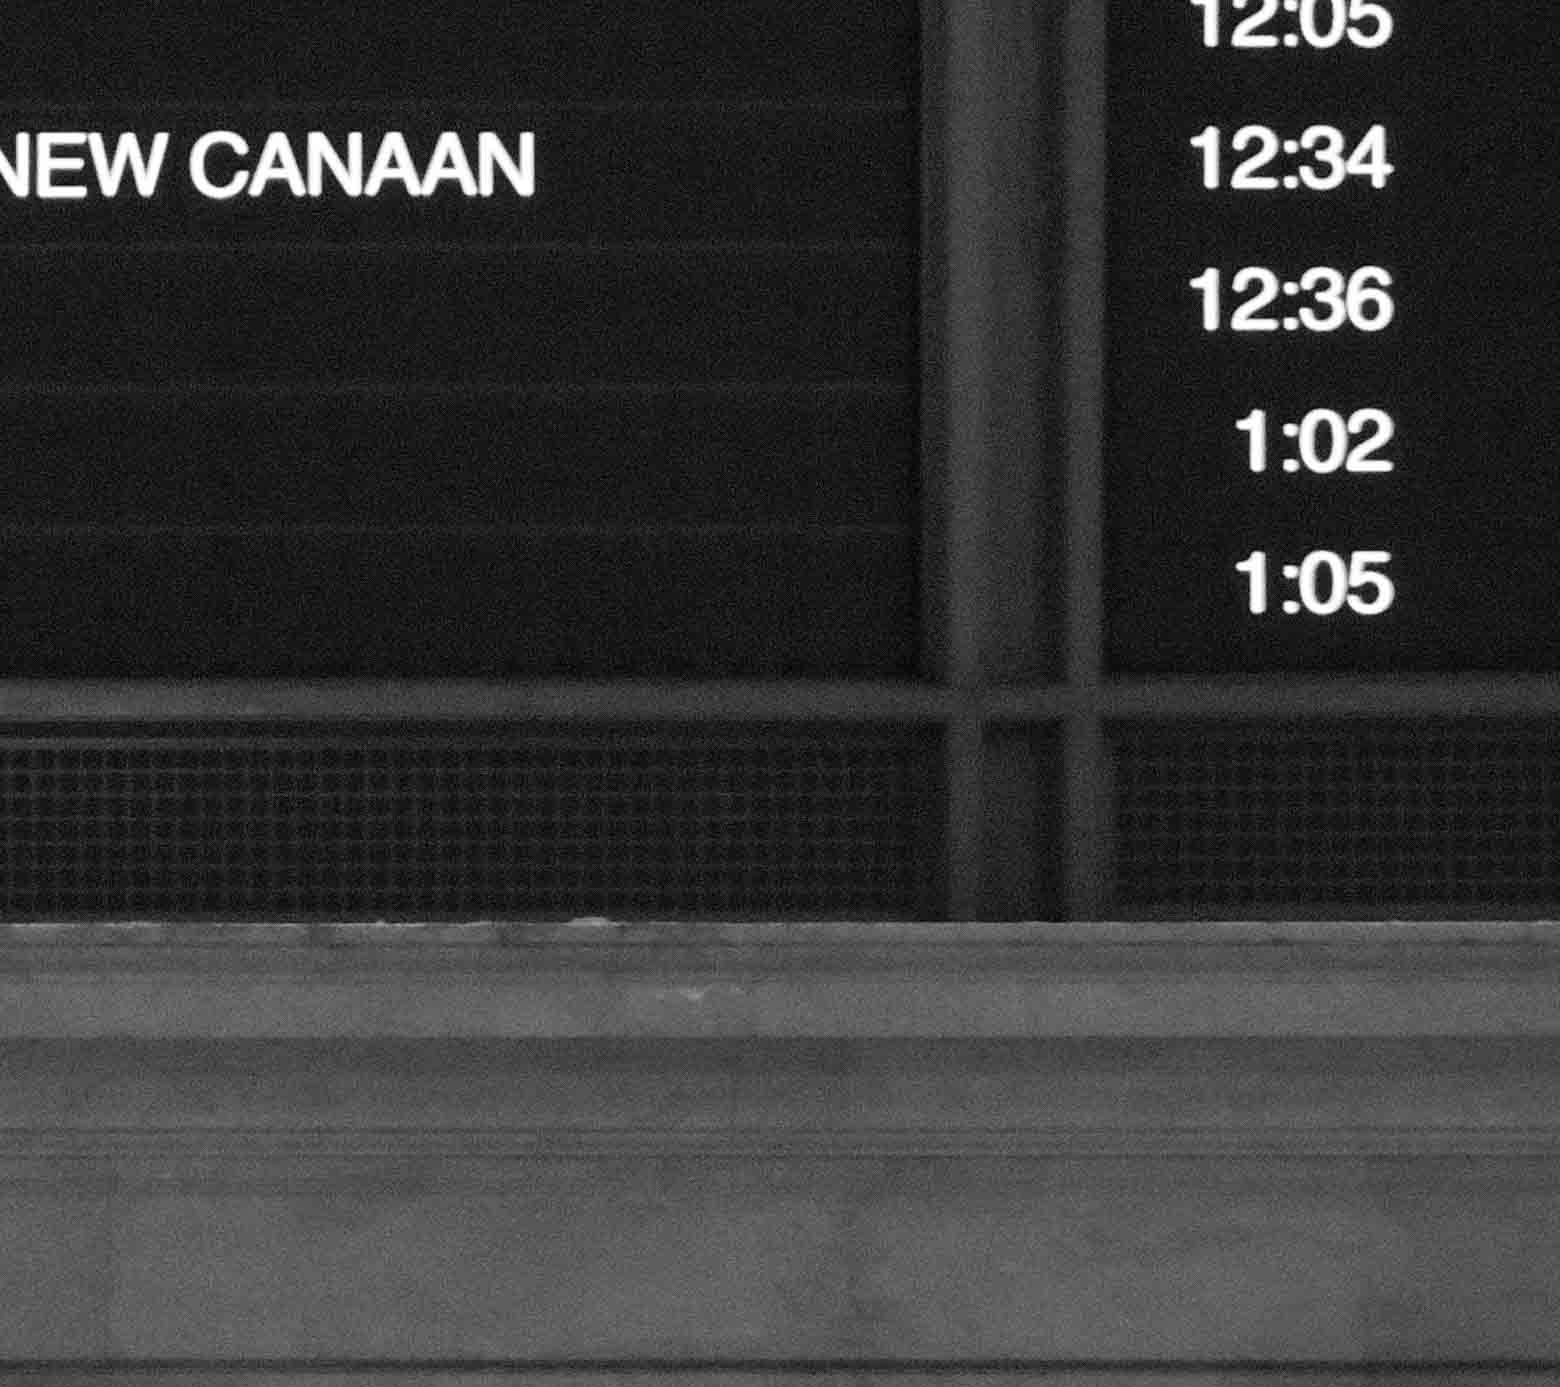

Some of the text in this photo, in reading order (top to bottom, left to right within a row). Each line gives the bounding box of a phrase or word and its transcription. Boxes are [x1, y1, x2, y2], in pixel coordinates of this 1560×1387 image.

[1188, 0, 1395, 50] 12:05
[187, 128, 537, 202] CANAAN
[1188, 123, 1396, 192] 12:34
[1188, 264, 1396, 334] 12:36
[1234, 406, 1396, 475] 1:02
[1234, 548, 1397, 617] 1:05
